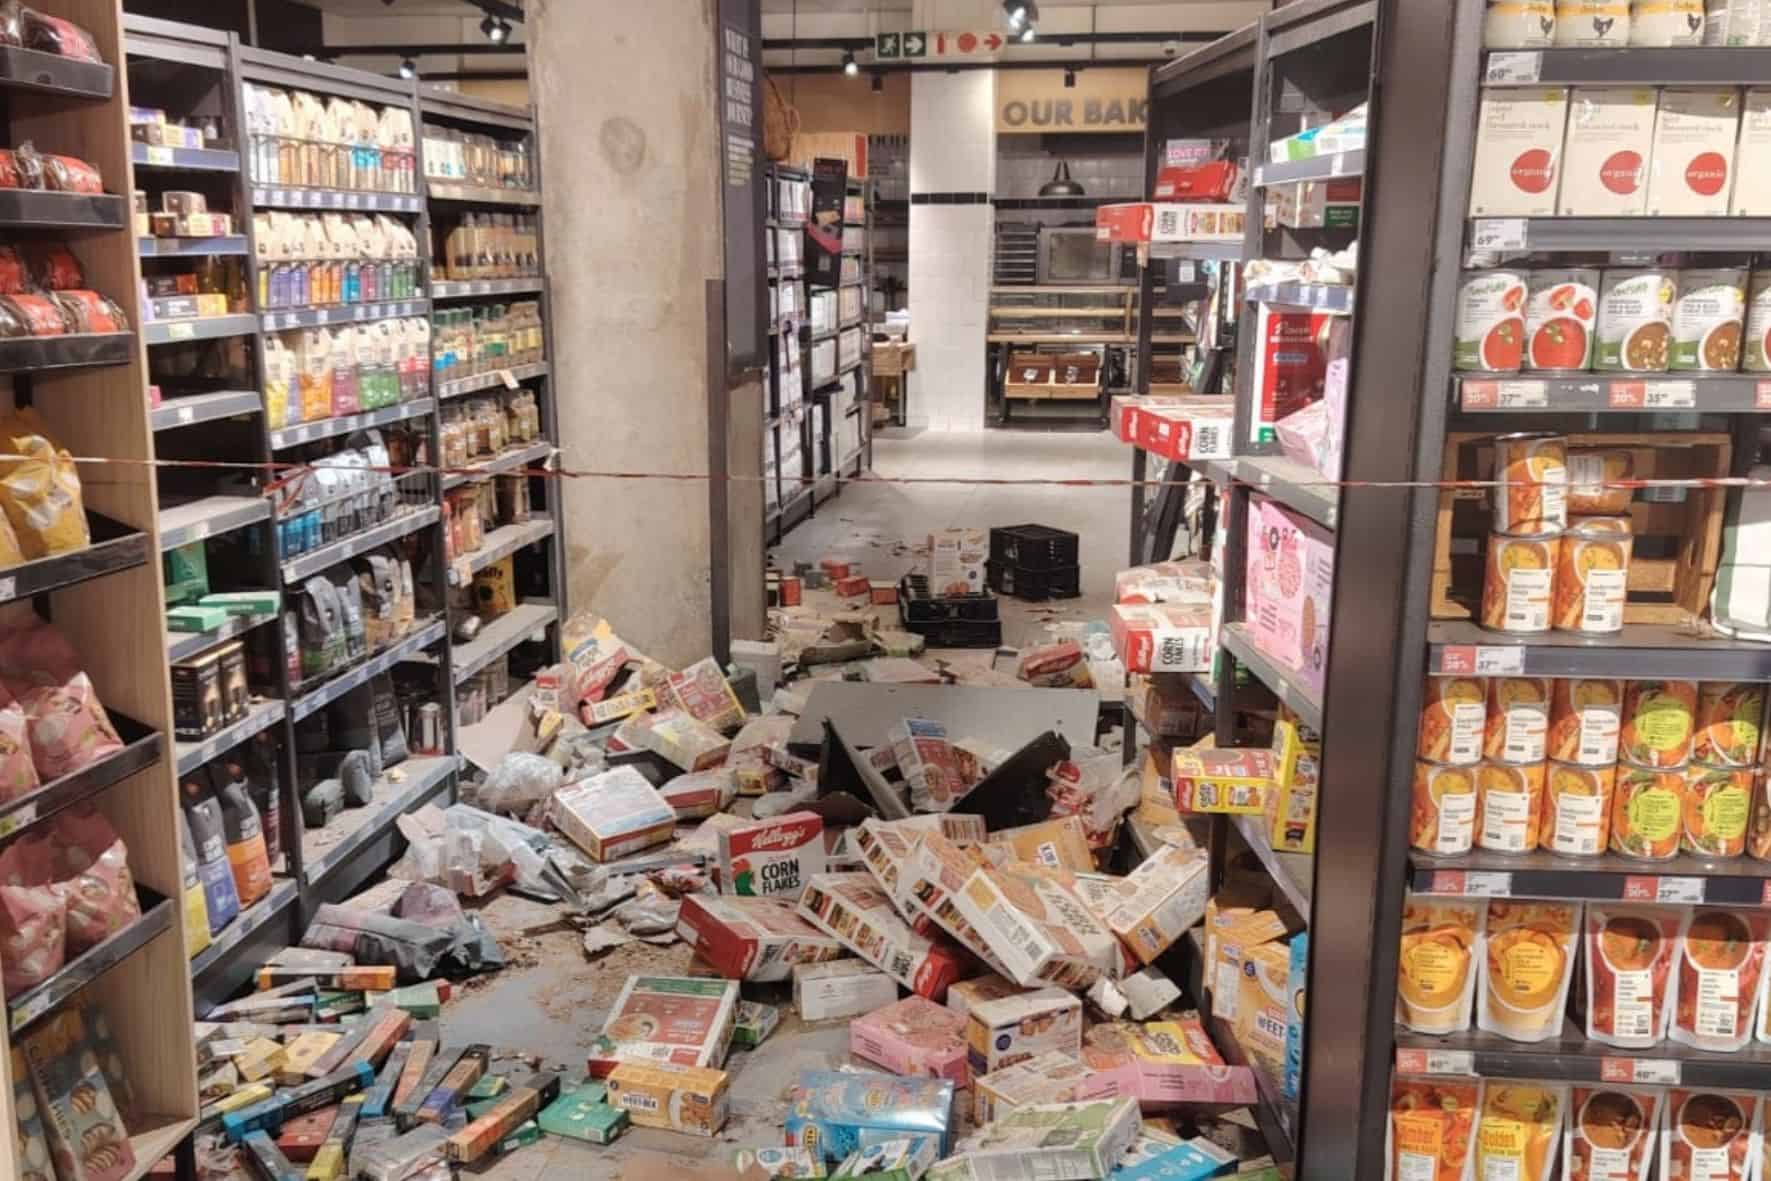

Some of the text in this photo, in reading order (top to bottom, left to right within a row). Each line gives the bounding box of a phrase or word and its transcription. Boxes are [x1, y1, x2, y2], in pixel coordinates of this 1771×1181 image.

[1003, 100, 1072, 126] OUR
[1162, 637, 1174, 665] CORN
[761, 858, 799, 881] CORN
[762, 876, 800, 894] FLAKES
